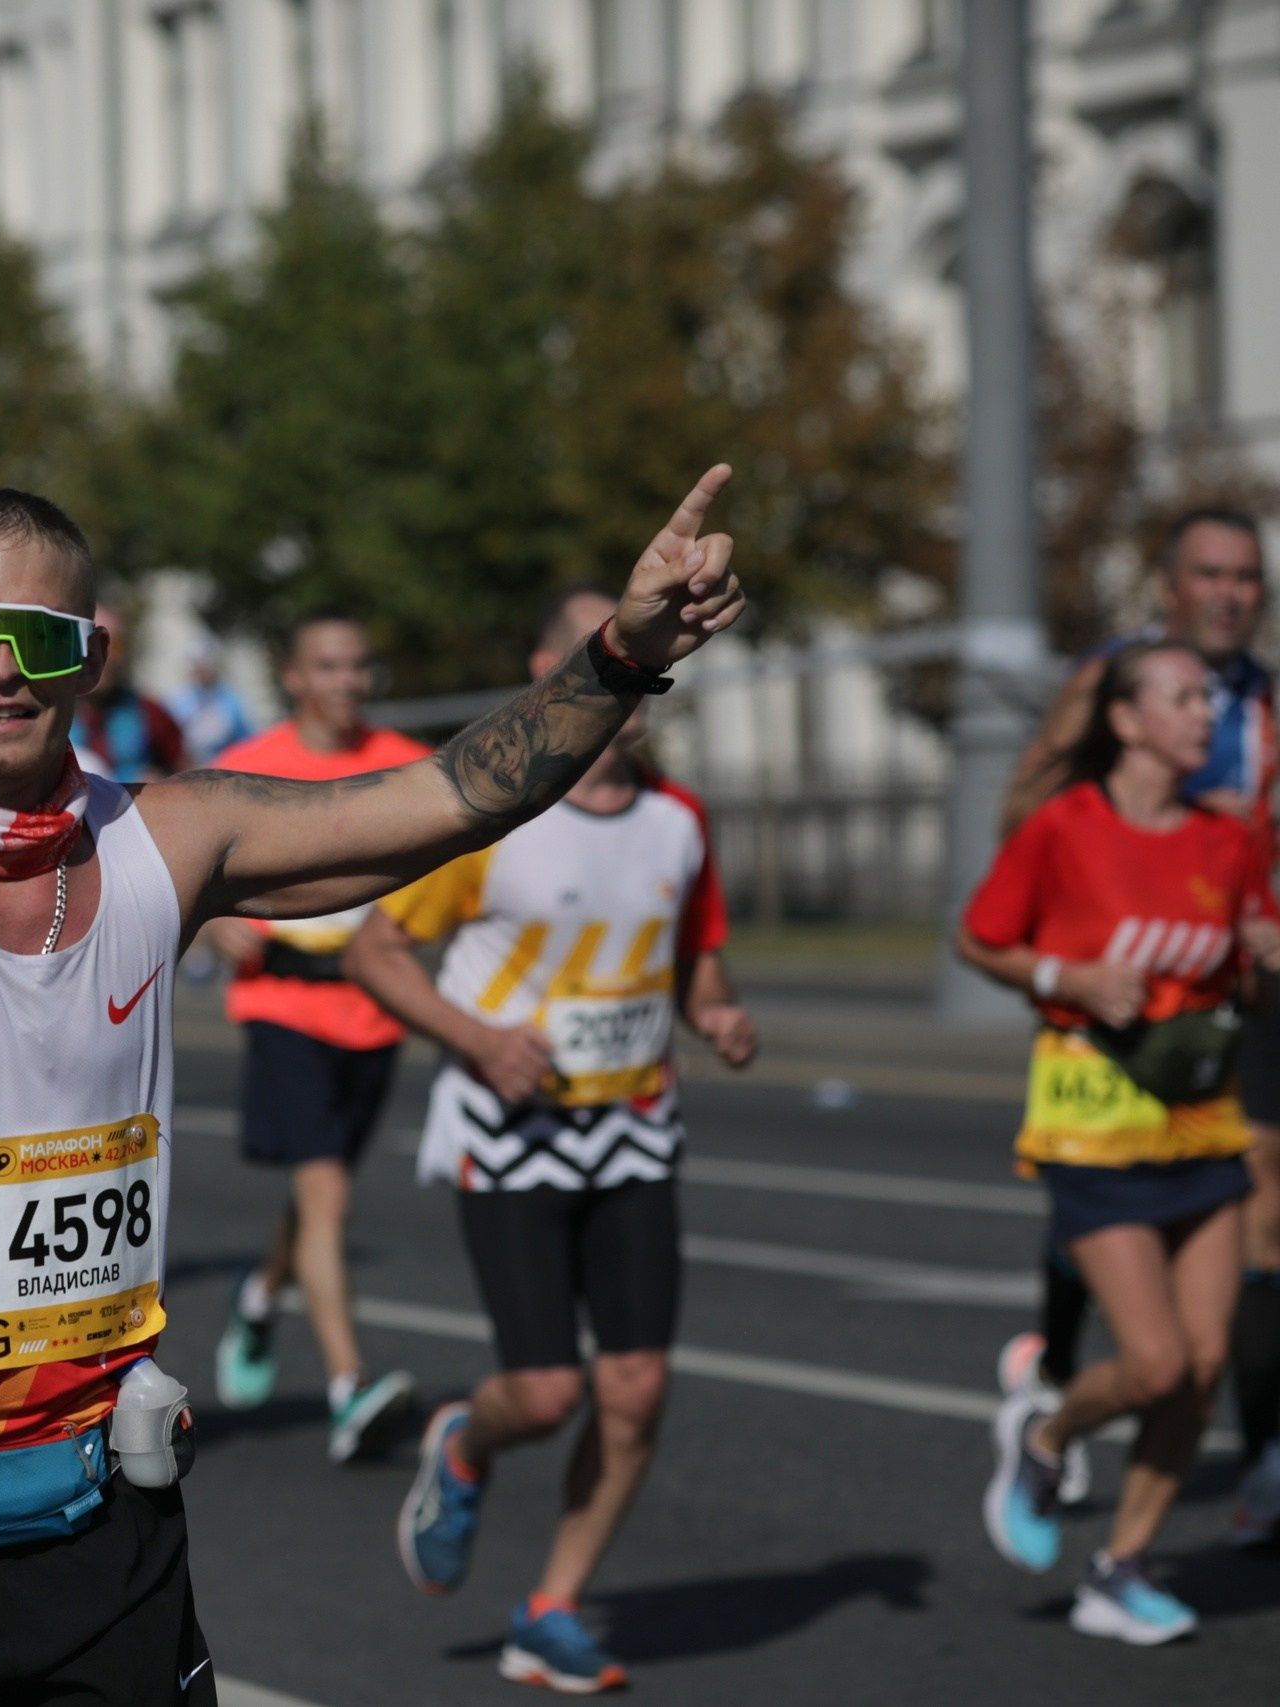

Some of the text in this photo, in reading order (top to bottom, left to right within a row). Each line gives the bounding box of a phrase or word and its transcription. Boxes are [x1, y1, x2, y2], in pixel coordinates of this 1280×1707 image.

[20, 1134, 103, 1159] МАРАФОН
[21, 1152, 90, 1174] МОСКВА
[18, 1263, 120, 1297] ВЛАДИСЛАВ
